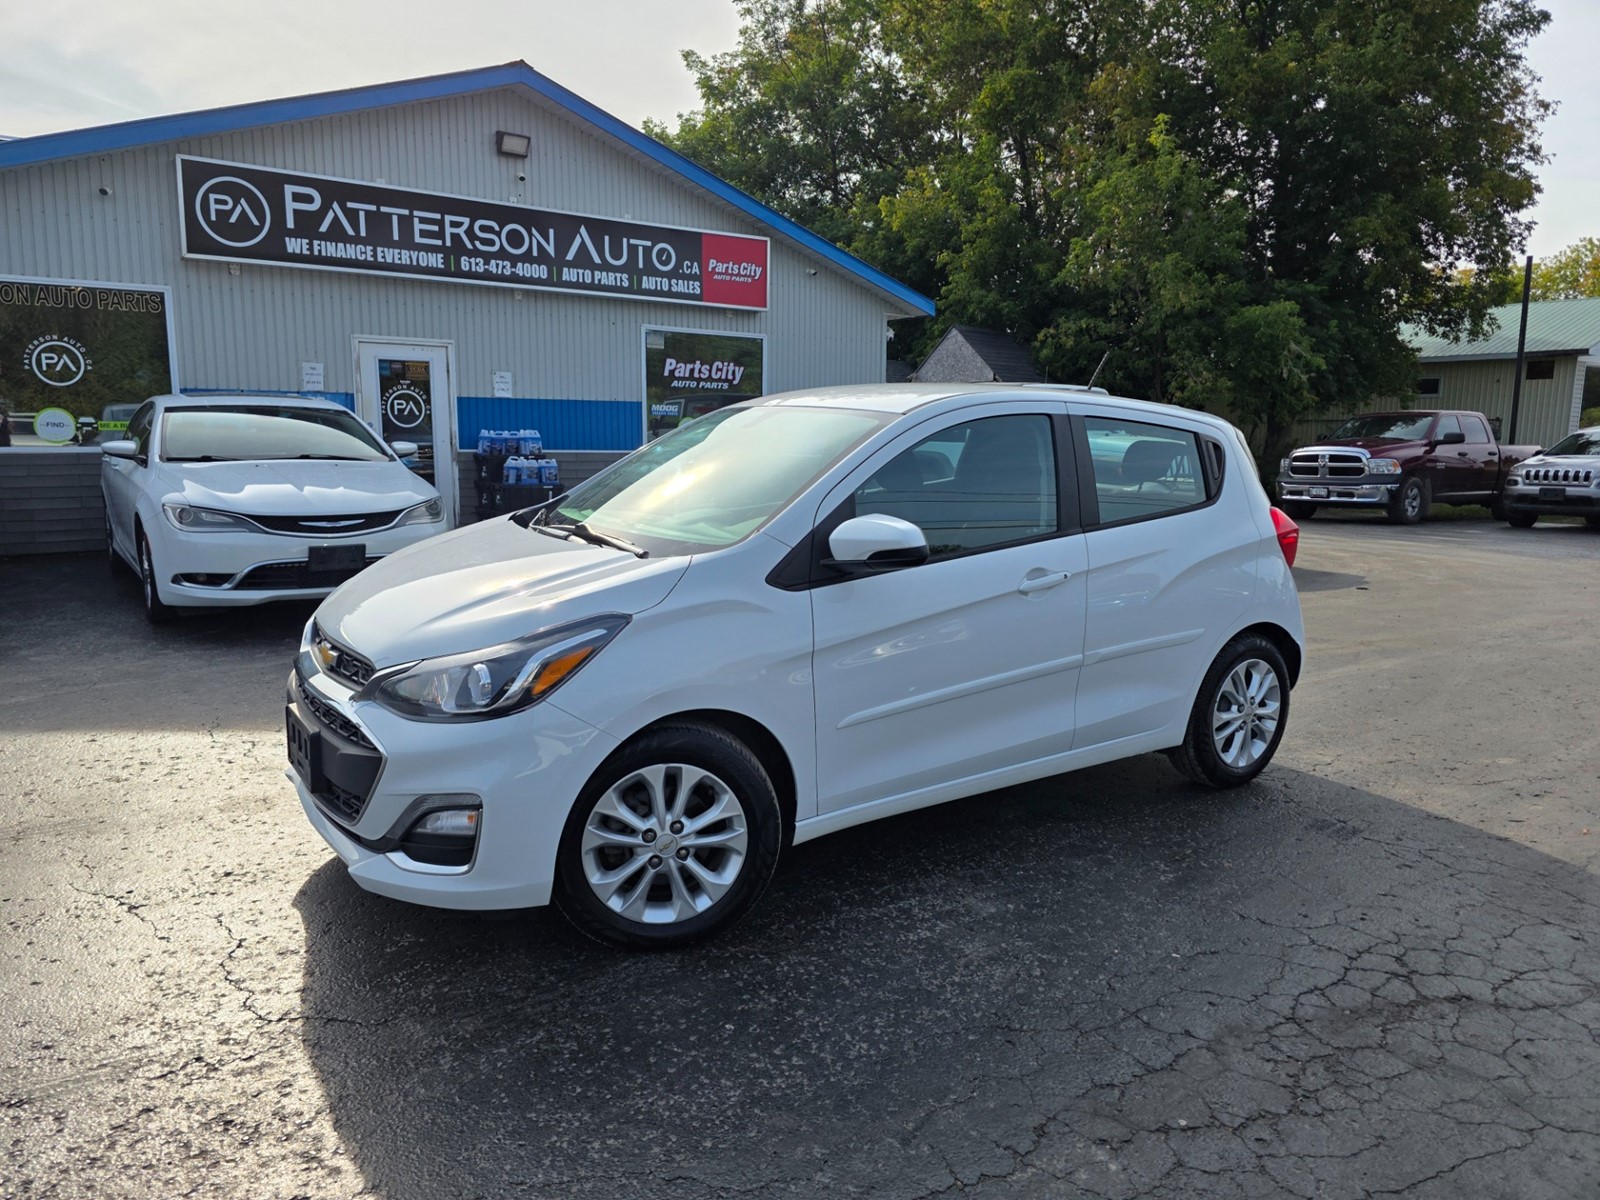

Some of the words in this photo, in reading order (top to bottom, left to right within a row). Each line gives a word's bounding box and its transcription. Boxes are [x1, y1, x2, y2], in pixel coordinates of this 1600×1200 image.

[284, 184, 555, 258] PATTERSON
[285, 237, 310, 255] WE
[313, 239, 374, 262] FINANCE
[376, 246, 445, 269] EVERYONE
[460, 256, 548, 279] 613-473-4000
[562, 267, 592, 284] AUTO
[594, 270, 629, 288] PARTS
[641, 275, 669, 291] AUTO
[670, 278, 701, 294] SALES
[35, 285, 92, 309] AUTO
[97, 289, 162, 313] PARTS
[24, 334, 58, 370] PATTERSON
[671, 380, 697, 388] AUTO
[699, 381, 728, 389] PARTS
[381, 384, 407, 414] PATTERSON
[651, 404, 679, 412] MOOG
[46, 421, 65, 429] FIND
[100, 422, 110, 430] ME
[112, 422, 119, 430] A
